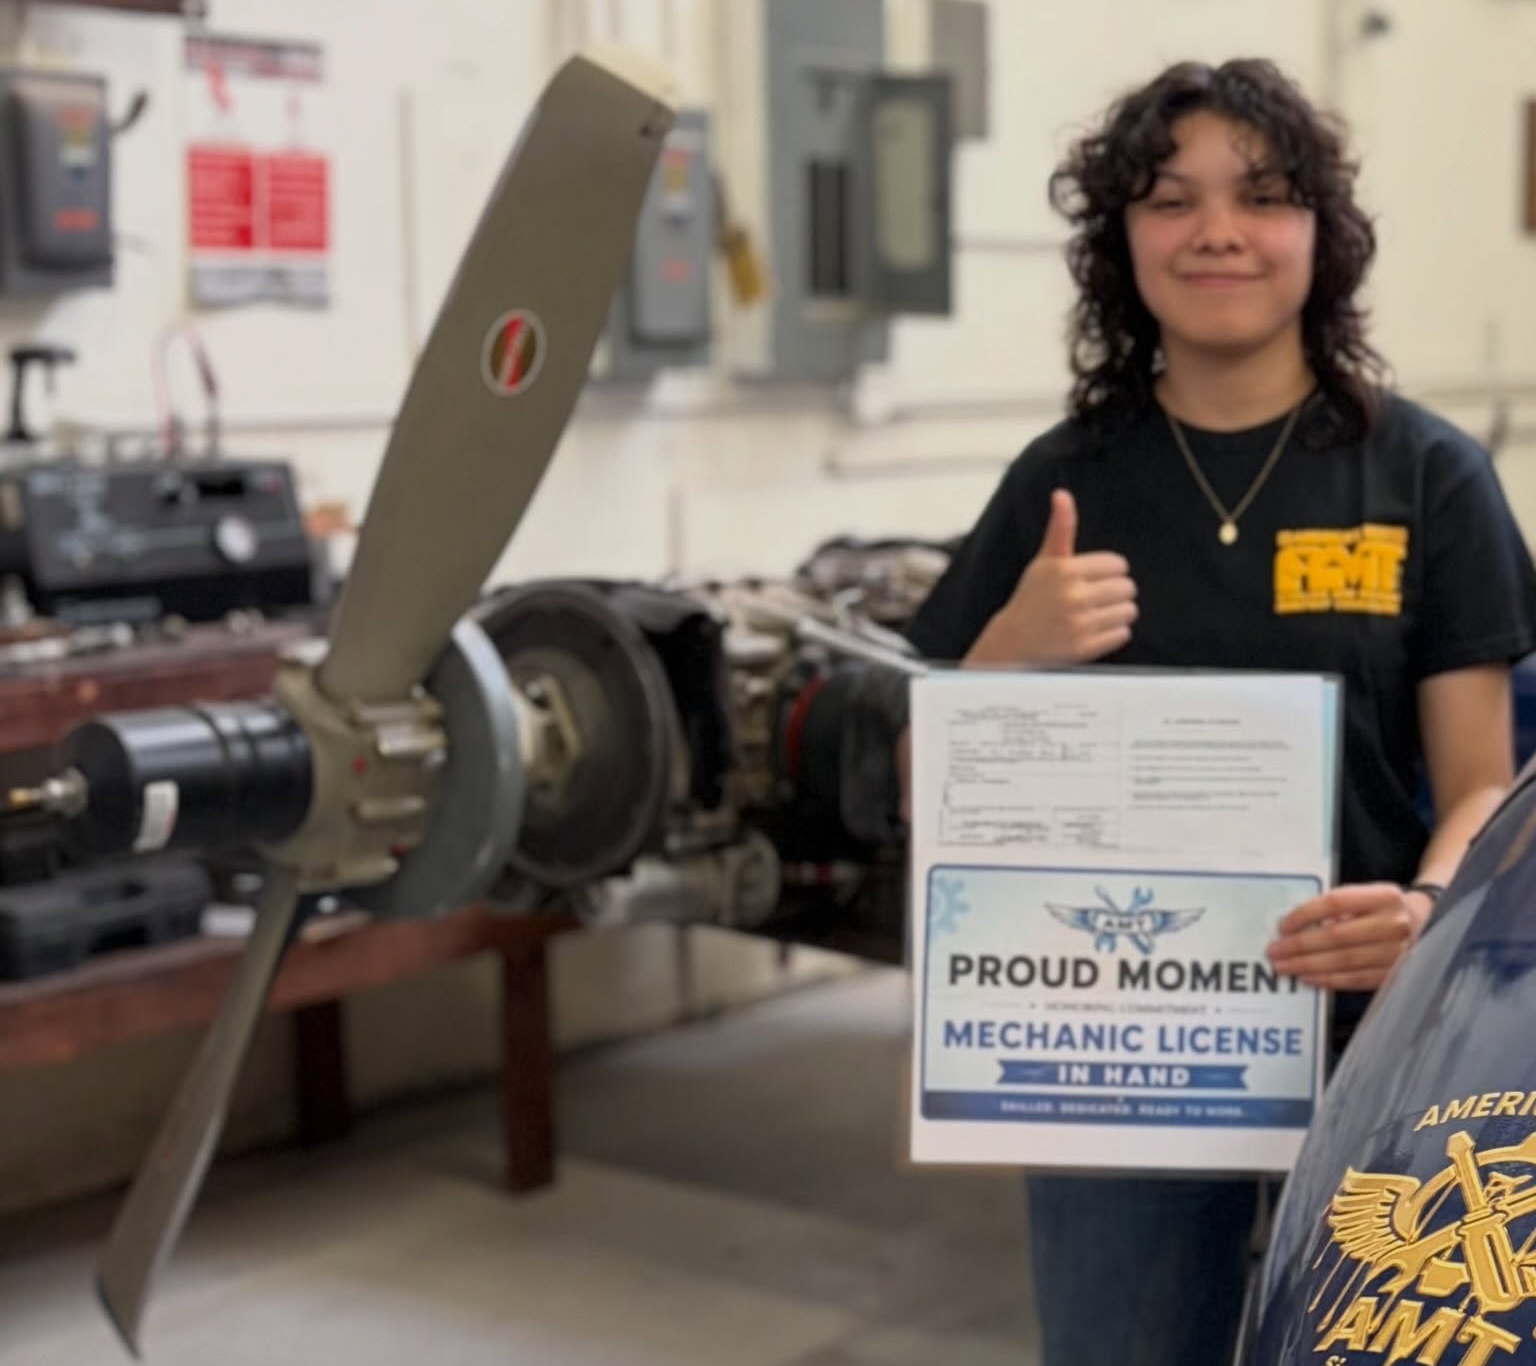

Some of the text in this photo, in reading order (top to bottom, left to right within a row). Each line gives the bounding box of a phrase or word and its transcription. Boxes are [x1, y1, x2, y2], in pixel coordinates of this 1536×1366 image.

[948, 954, 1099, 989] PROUD
[943, 1020, 1304, 1056] MECHANIC LICENSE
[1057, 1064, 1191, 1087] IN HAND
